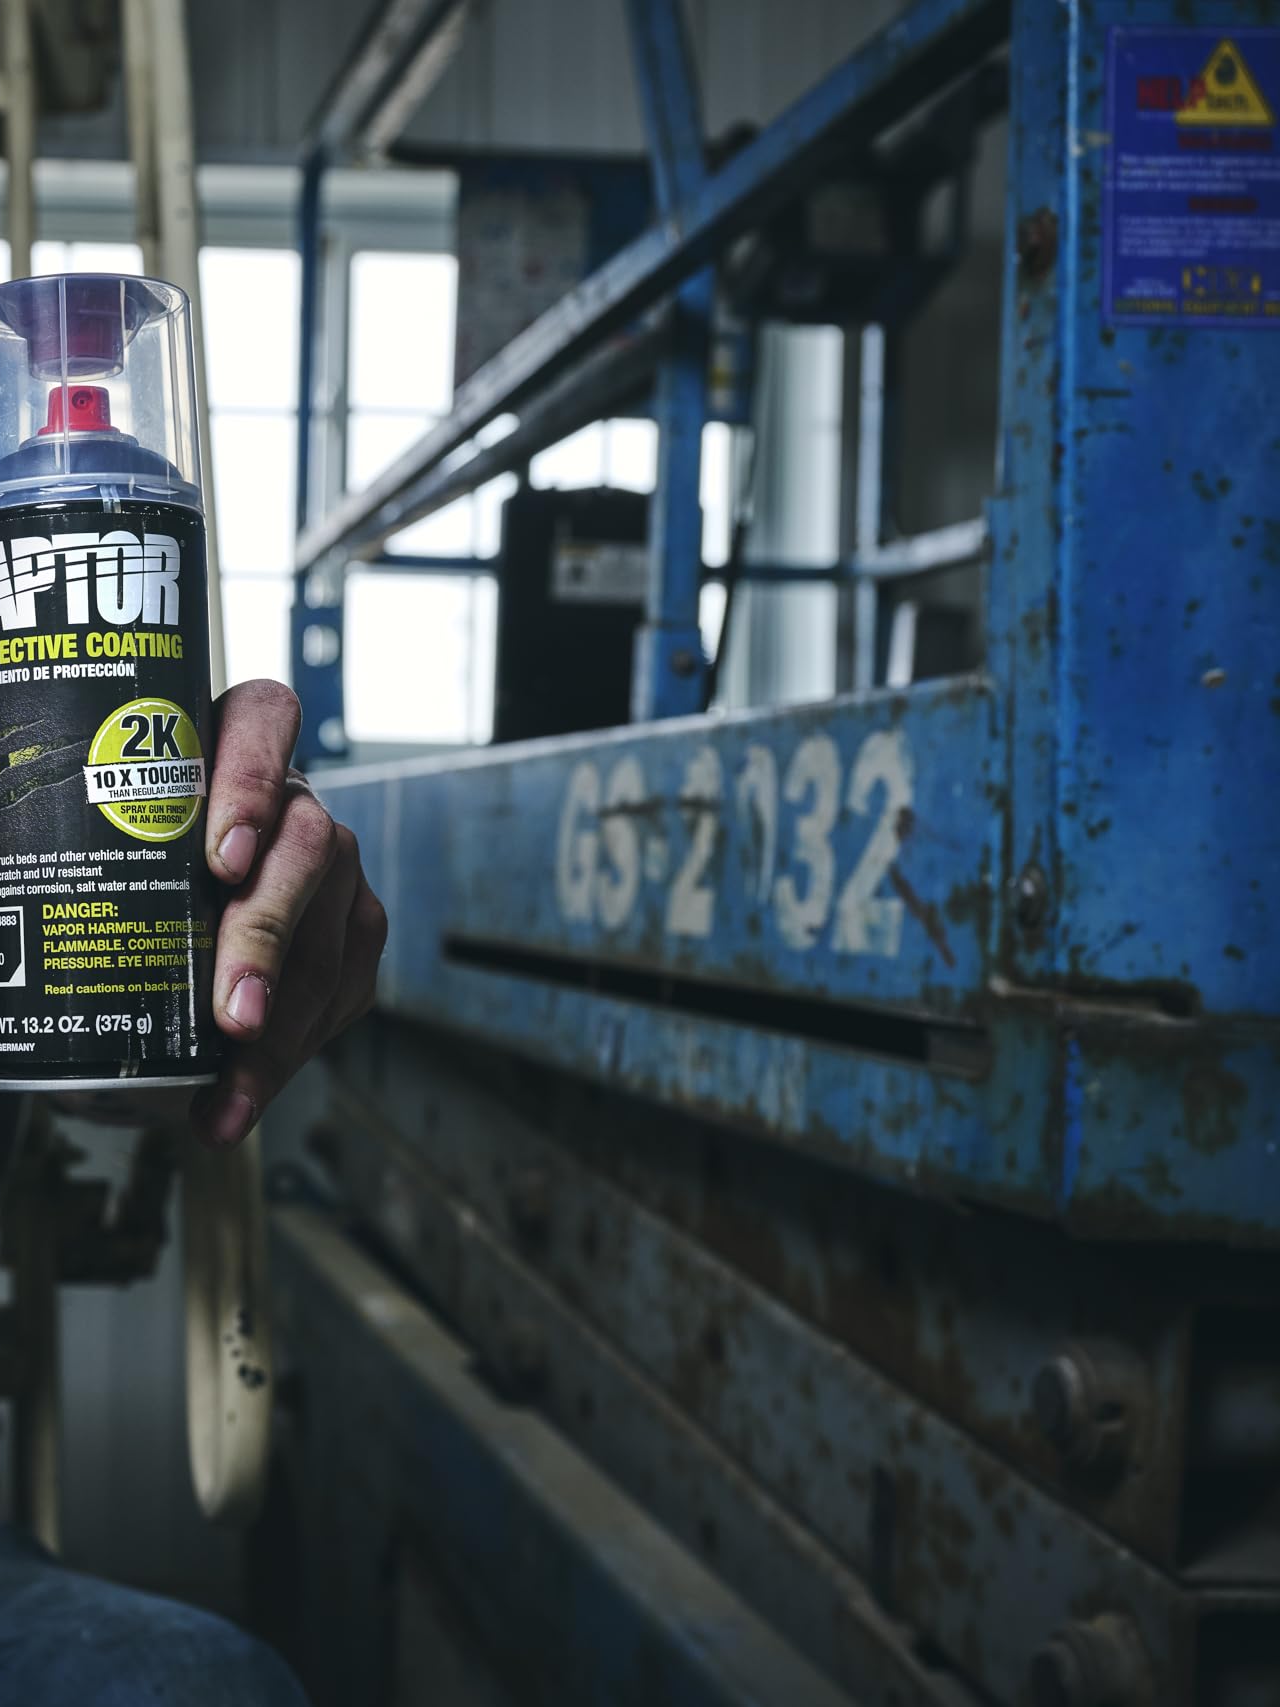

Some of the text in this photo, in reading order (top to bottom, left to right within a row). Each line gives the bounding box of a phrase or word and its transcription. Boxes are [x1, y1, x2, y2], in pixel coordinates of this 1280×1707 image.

[86, 632, 183, 659] COATING
[34, 666, 50, 680] DE
[54, 660, 135, 678] PROTECCIÓN
[120, 713, 183, 759] 2K
[93, 765, 202, 789] 10 X TOUGHER
[109, 784, 196, 798] THAN REGULAR AEROSOLS
[120, 805, 187, 814] SPRAY GUN FINISH
[129, 814, 184, 824] IN AN AEROSOL
[16, 853, 37, 865] beds
[39, 852, 58, 864] and
[60, 851, 86, 862] other
[88, 850, 124, 862] vehicle
[126, 849, 167, 860] surfaces
[24, 868, 40, 880] and
[42, 867, 56, 878] UV
[57, 866, 102, 878] resistant
[26, 882, 74, 895] corrosion,
[76, 880, 96, 892] salt
[97, 880, 128, 892] water
[129, 880, 148, 891] and
[149, 879, 190, 890] chemicals
[42, 902, 119, 920] DANGER:
[42, 924, 85, 937] VAPOR
[88, 922, 152, 936] HARMFUL.
[43, 940, 125, 954] FLAMMABLE.
[128, 937, 188, 951] CONTENTS
[44, 956, 116, 971] PRESSURE.
[118, 956, 142, 968] EYE
[44, 984, 74, 995] Read
[76, 982, 125, 994] cautions
[128, 984, 143, 993] on
[144, 982, 170, 992] back
[21, 1016, 54, 1034] 13.2
[58, 1016, 90, 1034] OZ.
[96, 1014, 132, 1036] (375
[136, 1013, 153, 1035] g)
